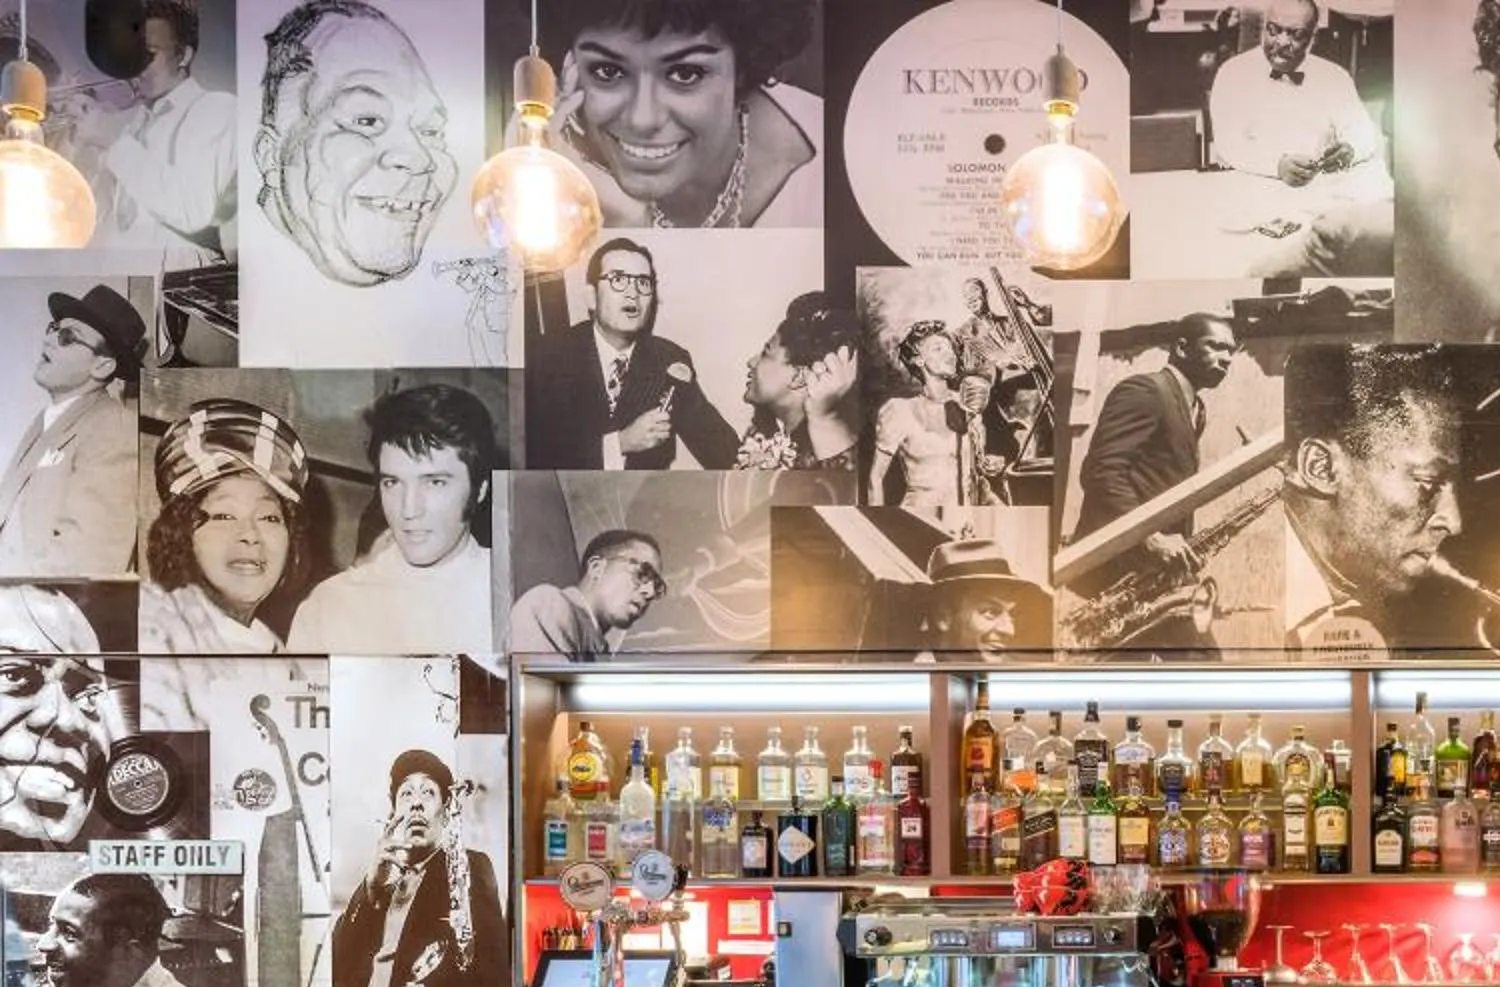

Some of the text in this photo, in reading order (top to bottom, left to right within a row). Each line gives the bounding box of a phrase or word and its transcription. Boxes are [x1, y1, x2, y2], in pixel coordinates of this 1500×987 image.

[903, 69, 1089, 95] KENWO
[99, 845, 231, 867] STAFF ONLY
